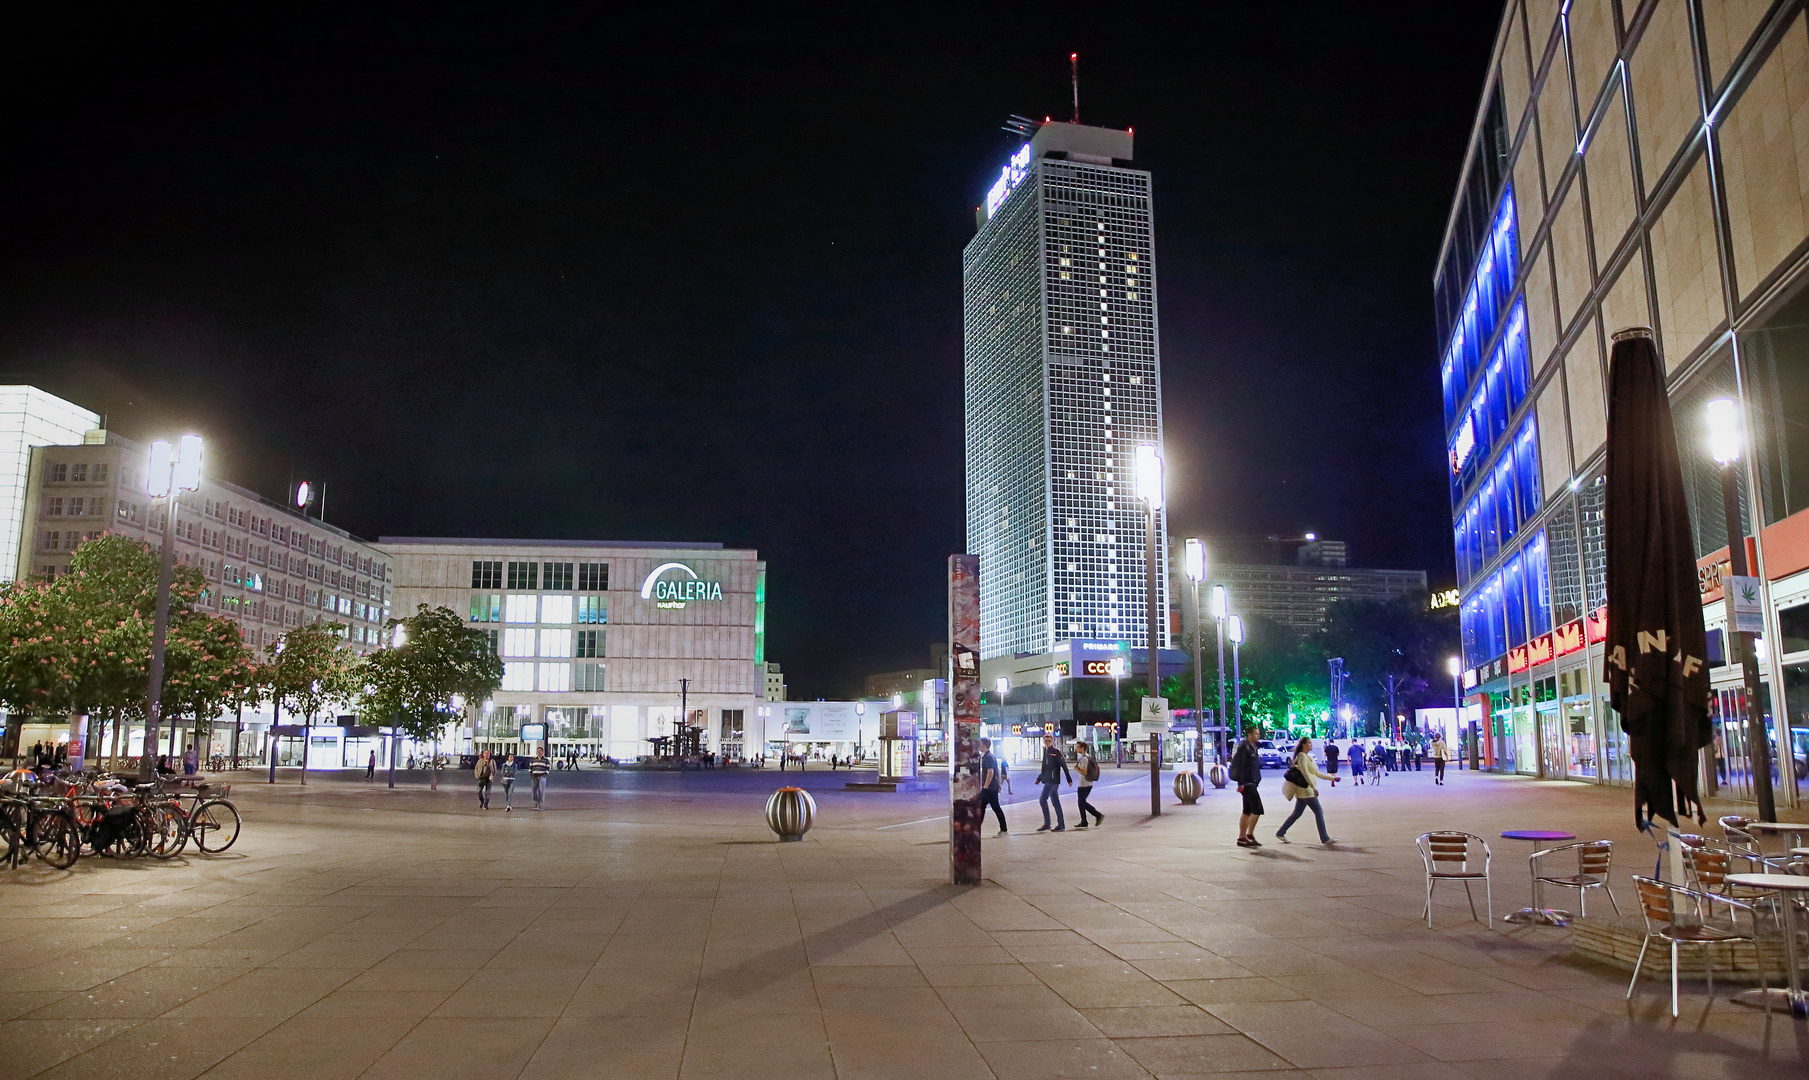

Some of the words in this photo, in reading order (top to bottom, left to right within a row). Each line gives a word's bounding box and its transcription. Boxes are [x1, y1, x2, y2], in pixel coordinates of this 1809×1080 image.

[656, 580, 723, 601] GALERIA
[1430, 589, 1460, 609] ADAC
[1083, 642, 1119, 651] PRIMARK
